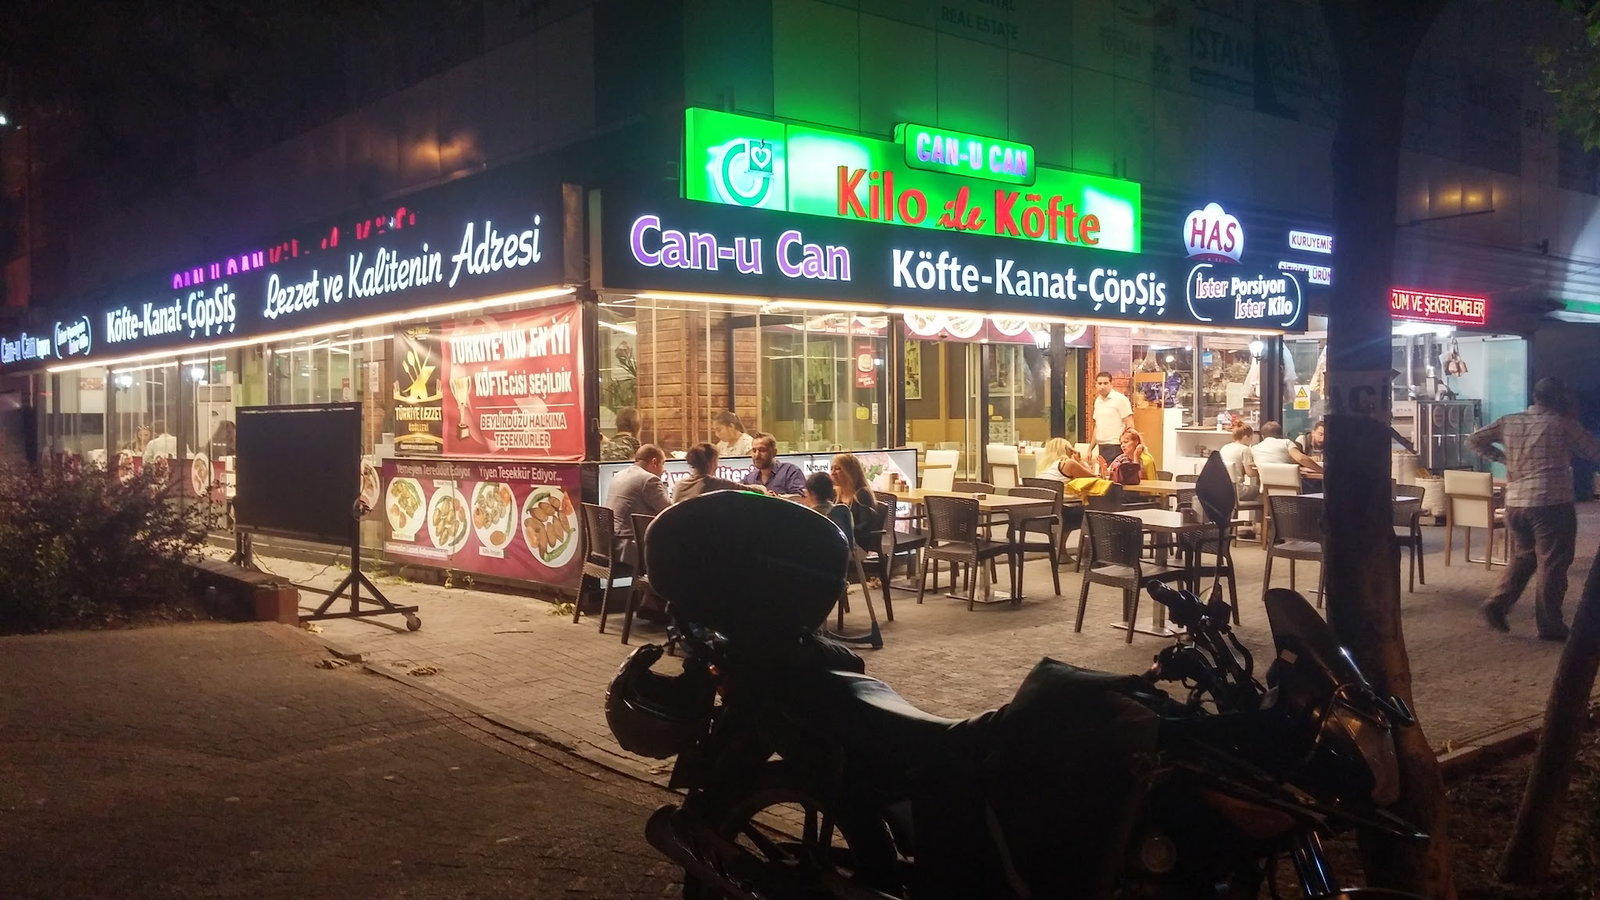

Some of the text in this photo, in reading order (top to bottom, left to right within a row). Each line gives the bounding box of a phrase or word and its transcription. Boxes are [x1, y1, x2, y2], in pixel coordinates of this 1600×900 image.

[916, 131, 1028, 178] CAN-U CAN
[837, 165, 1101, 245] Kilo ile Köfte
[630, 214, 851, 281] Can-u Can
[1190, 217, 1237, 253] HAS
[263, 269, 319, 319] Lezzet
[323, 274, 343, 304] ve
[348, 242, 444, 299] Kalitenin
[449, 214, 541, 288] Adresi
[1195, 272, 1286, 300] İster Porsiyon
[1234, 293, 1293, 319] İster Kilo
[1410, 294, 1423, 312] VE
[1424, 295, 1485, 318] ŞEKERLEMELER
[528, 325, 548, 358] EN
[529, 366, 573, 400] SEÇİLDİK
[529, 412, 567, 430] HALKINA
[498, 466, 531, 481] Teşekkür
